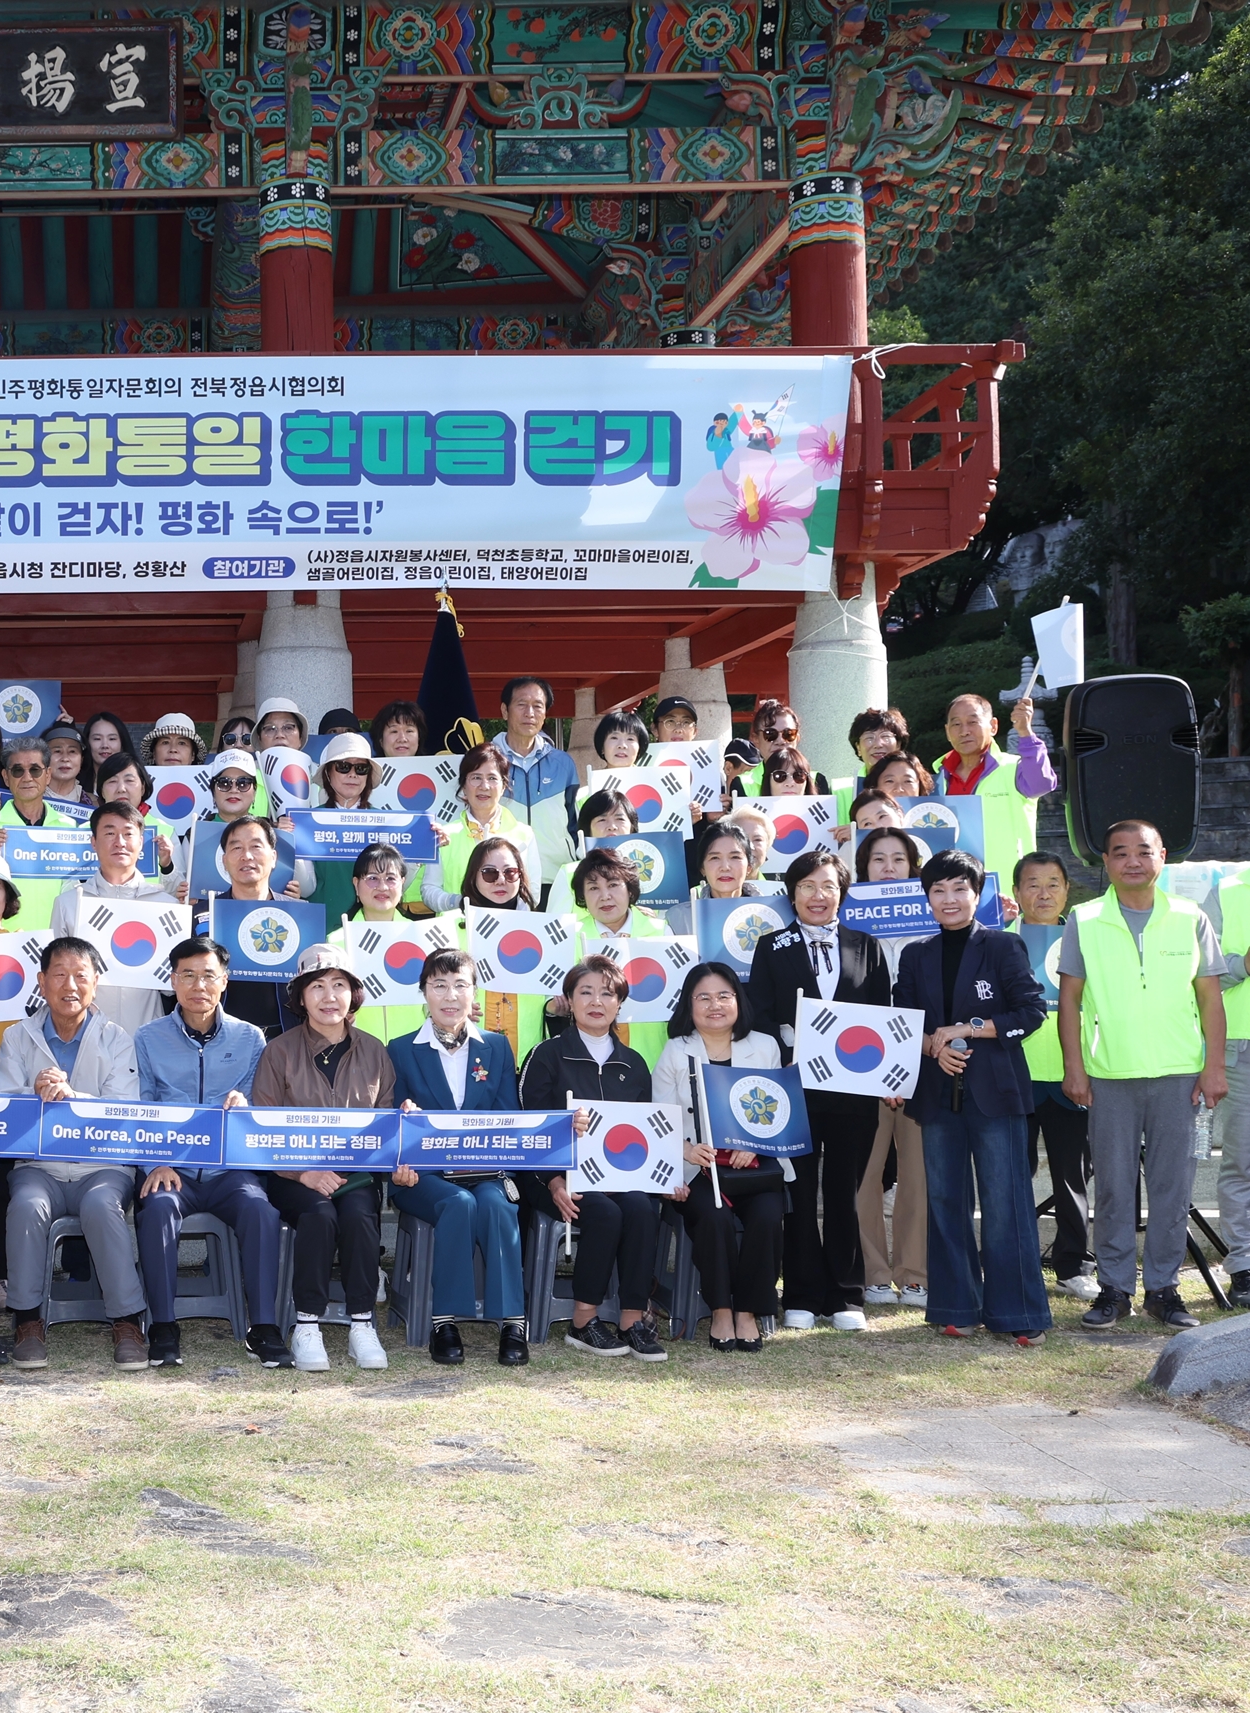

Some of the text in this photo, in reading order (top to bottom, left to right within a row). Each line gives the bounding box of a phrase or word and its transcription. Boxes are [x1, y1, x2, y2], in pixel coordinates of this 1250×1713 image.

[190, 376, 345, 398] 전북정읍시협의회
[283, 413, 511, 480] 한마음
[526, 413, 676, 480] 걷기
[57, 501, 144, 537] 걷자!
[158, 500, 234, 536] 평화
[307, 549, 694, 565] (사)정읍시자원봉사센터, 덕천초등학교, 꼬마마을어린이집,
[50, 561, 126, 580] 잔디마당,
[132, 561, 187, 579] 성황산
[213, 559, 286, 578] 참여기관
[306, 565, 588, 582] 샘골어린이집, 정읍어린이집, 태양어린이집
[1123, 735, 1157, 745] EON
[73, 807, 89, 817] 기원!
[340, 814, 386, 823] 평화통일 기원!
[56, 832, 85, 841] 평화통일
[313, 830, 412, 845] 평화, 함께 만들어요
[13, 848, 99, 863] One Korea, On
[880, 885, 913, 895] 평화통일
[845, 904, 891, 921] PEACE
[893, 902, 922, 916] FOR
[104, 1107, 160, 1118] 평화통일 기원!
[286, 1114, 341, 1124] 평화통일 기원!
[461, 1117, 515, 1127] 평화통일 기원!
[52, 1124, 211, 1146] One Korea, One Peace
[245, 1133, 381, 1149] 평화로 하나 되는 정읍!
[421, 1135, 552, 1150] 평화로 하나 되는 정읍!
